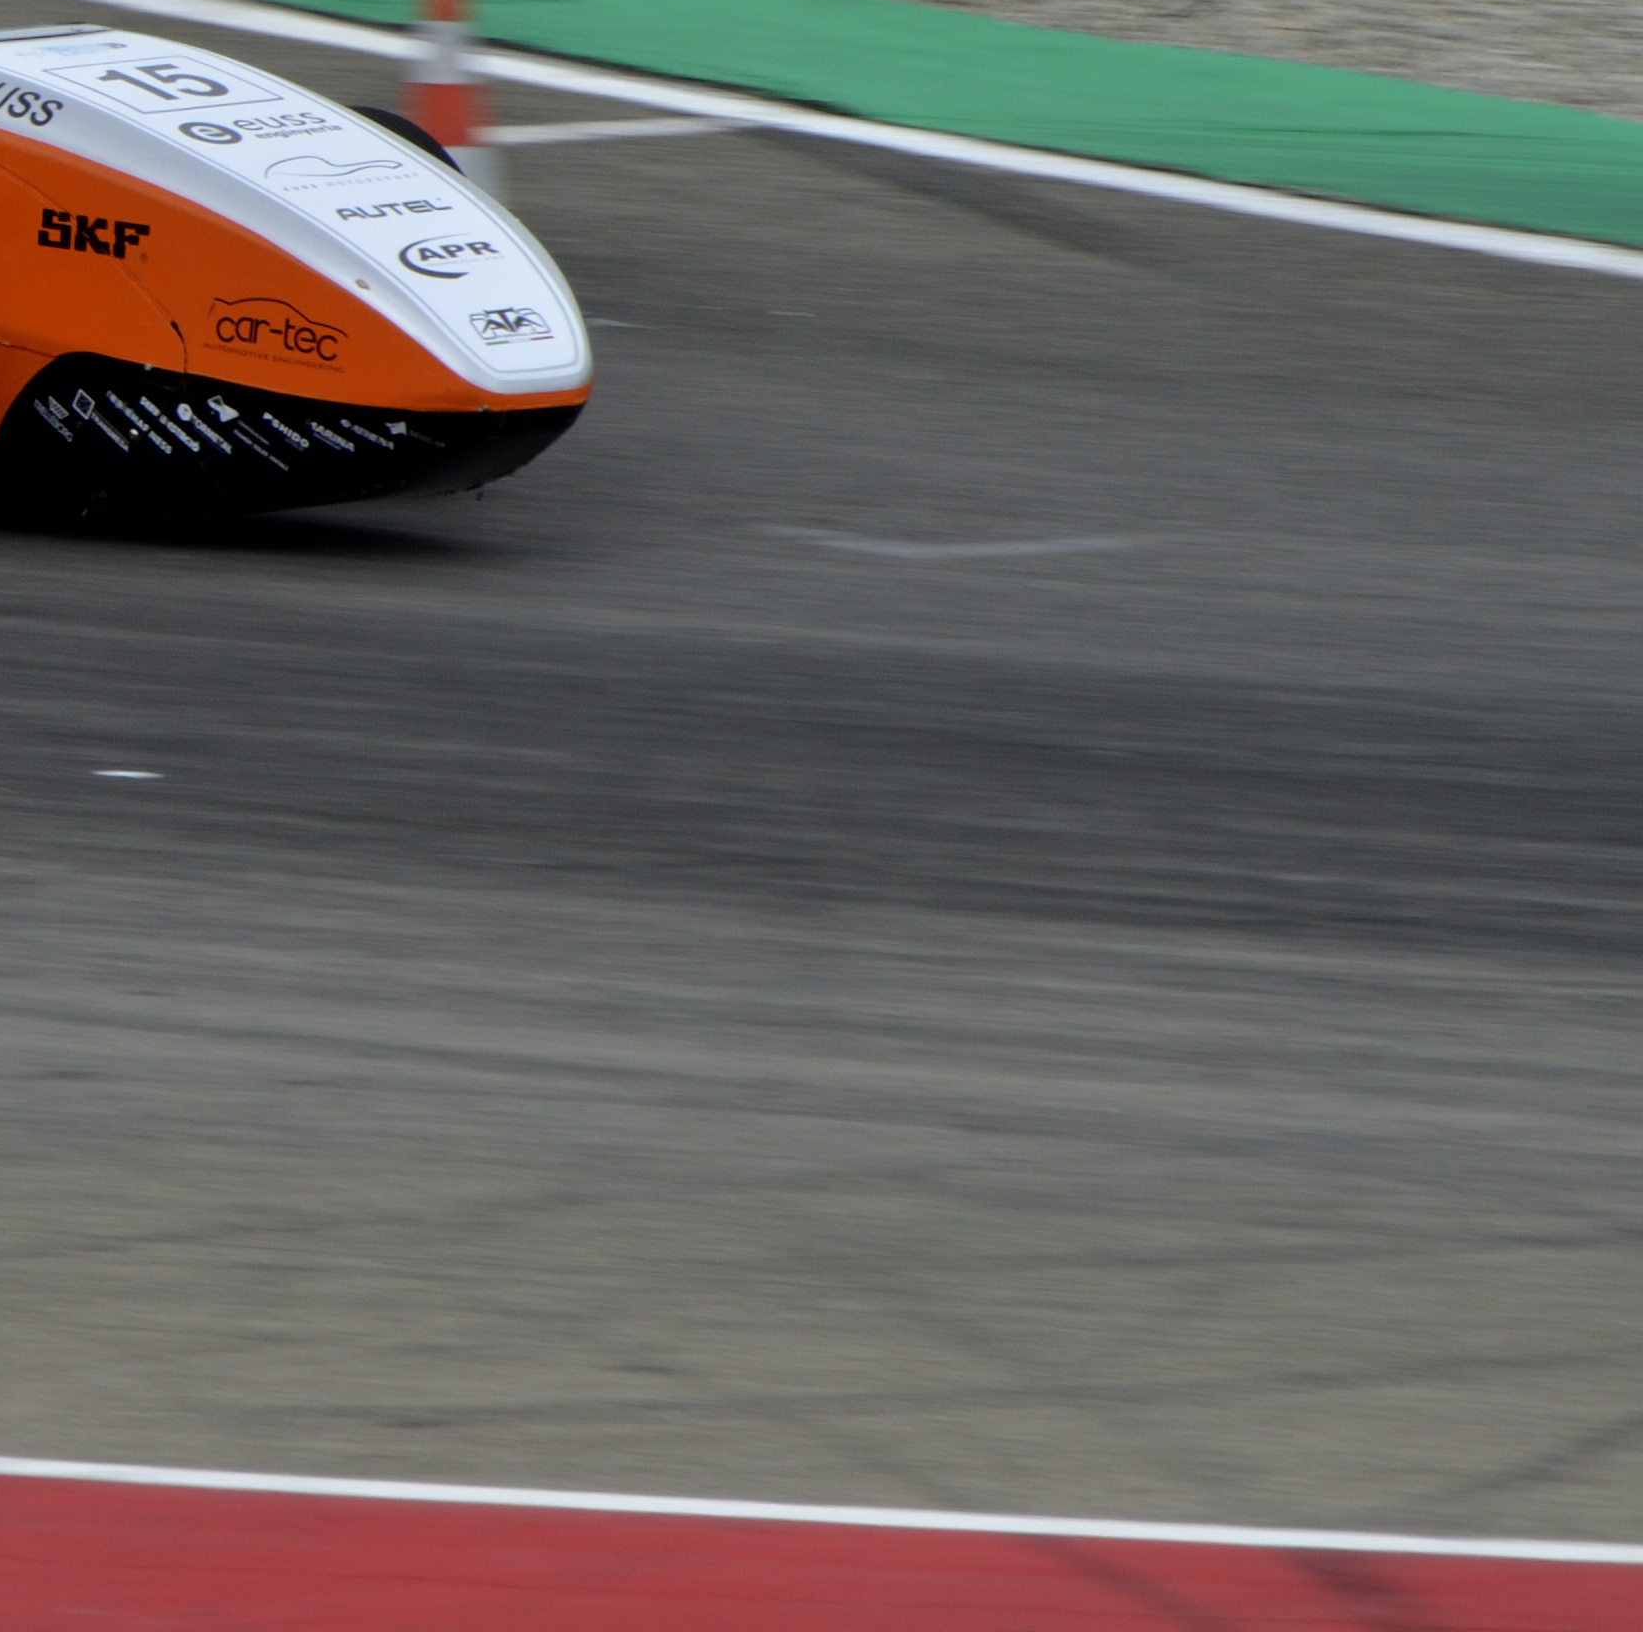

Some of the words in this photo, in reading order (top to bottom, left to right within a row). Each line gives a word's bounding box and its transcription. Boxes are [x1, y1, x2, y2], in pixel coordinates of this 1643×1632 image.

[97, 62, 229, 101] 15
[232, 112, 327, 132] euss
[254, 122, 343, 140] enginyeria
[336, 199, 453, 221] AUTEL
[37, 208, 150, 259] SKF
[417, 240, 500, 262] APR
[216, 316, 338, 361] car-tec
